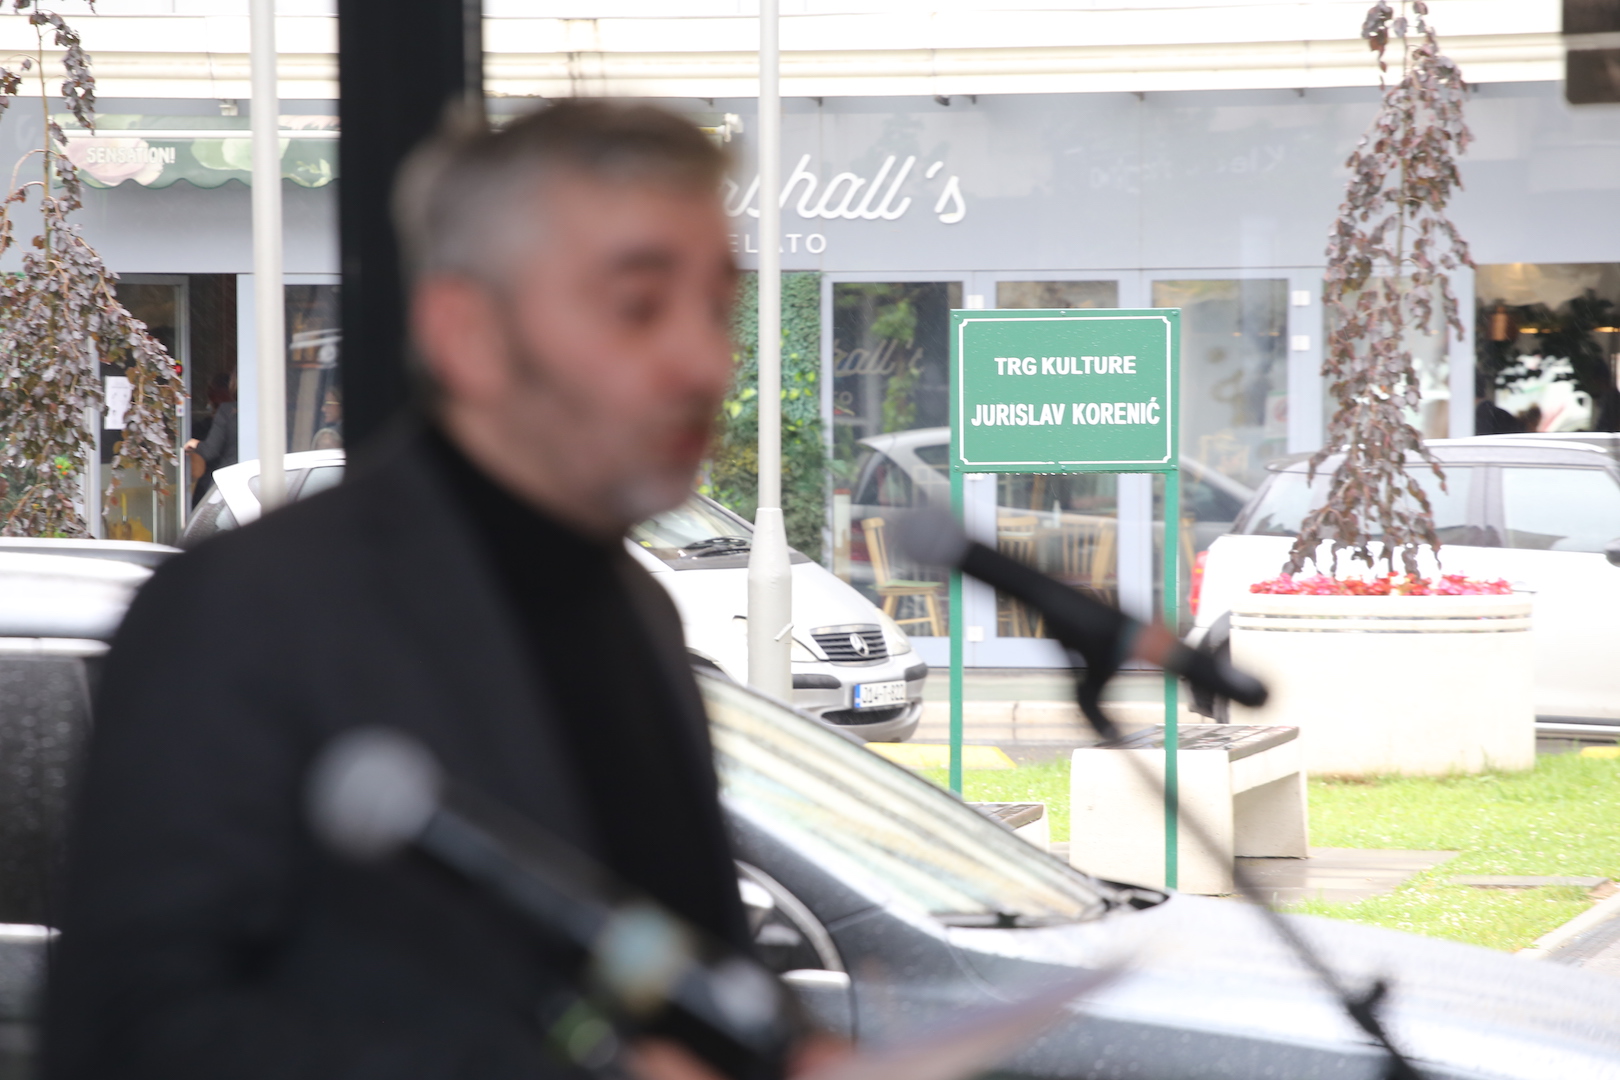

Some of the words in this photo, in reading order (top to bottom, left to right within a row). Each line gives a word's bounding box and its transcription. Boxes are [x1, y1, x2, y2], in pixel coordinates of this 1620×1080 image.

[86, 147, 175, 164] SENSATION!
[722, 154, 967, 224] rshall's
[727, 233, 827, 254] ELTO
[994, 357, 1037, 375] TRG
[1041, 355, 1137, 375] KULTURE
[971, 403, 1066, 427] JURISLAV
[1072, 396, 1161, 425] KORENIĆ
